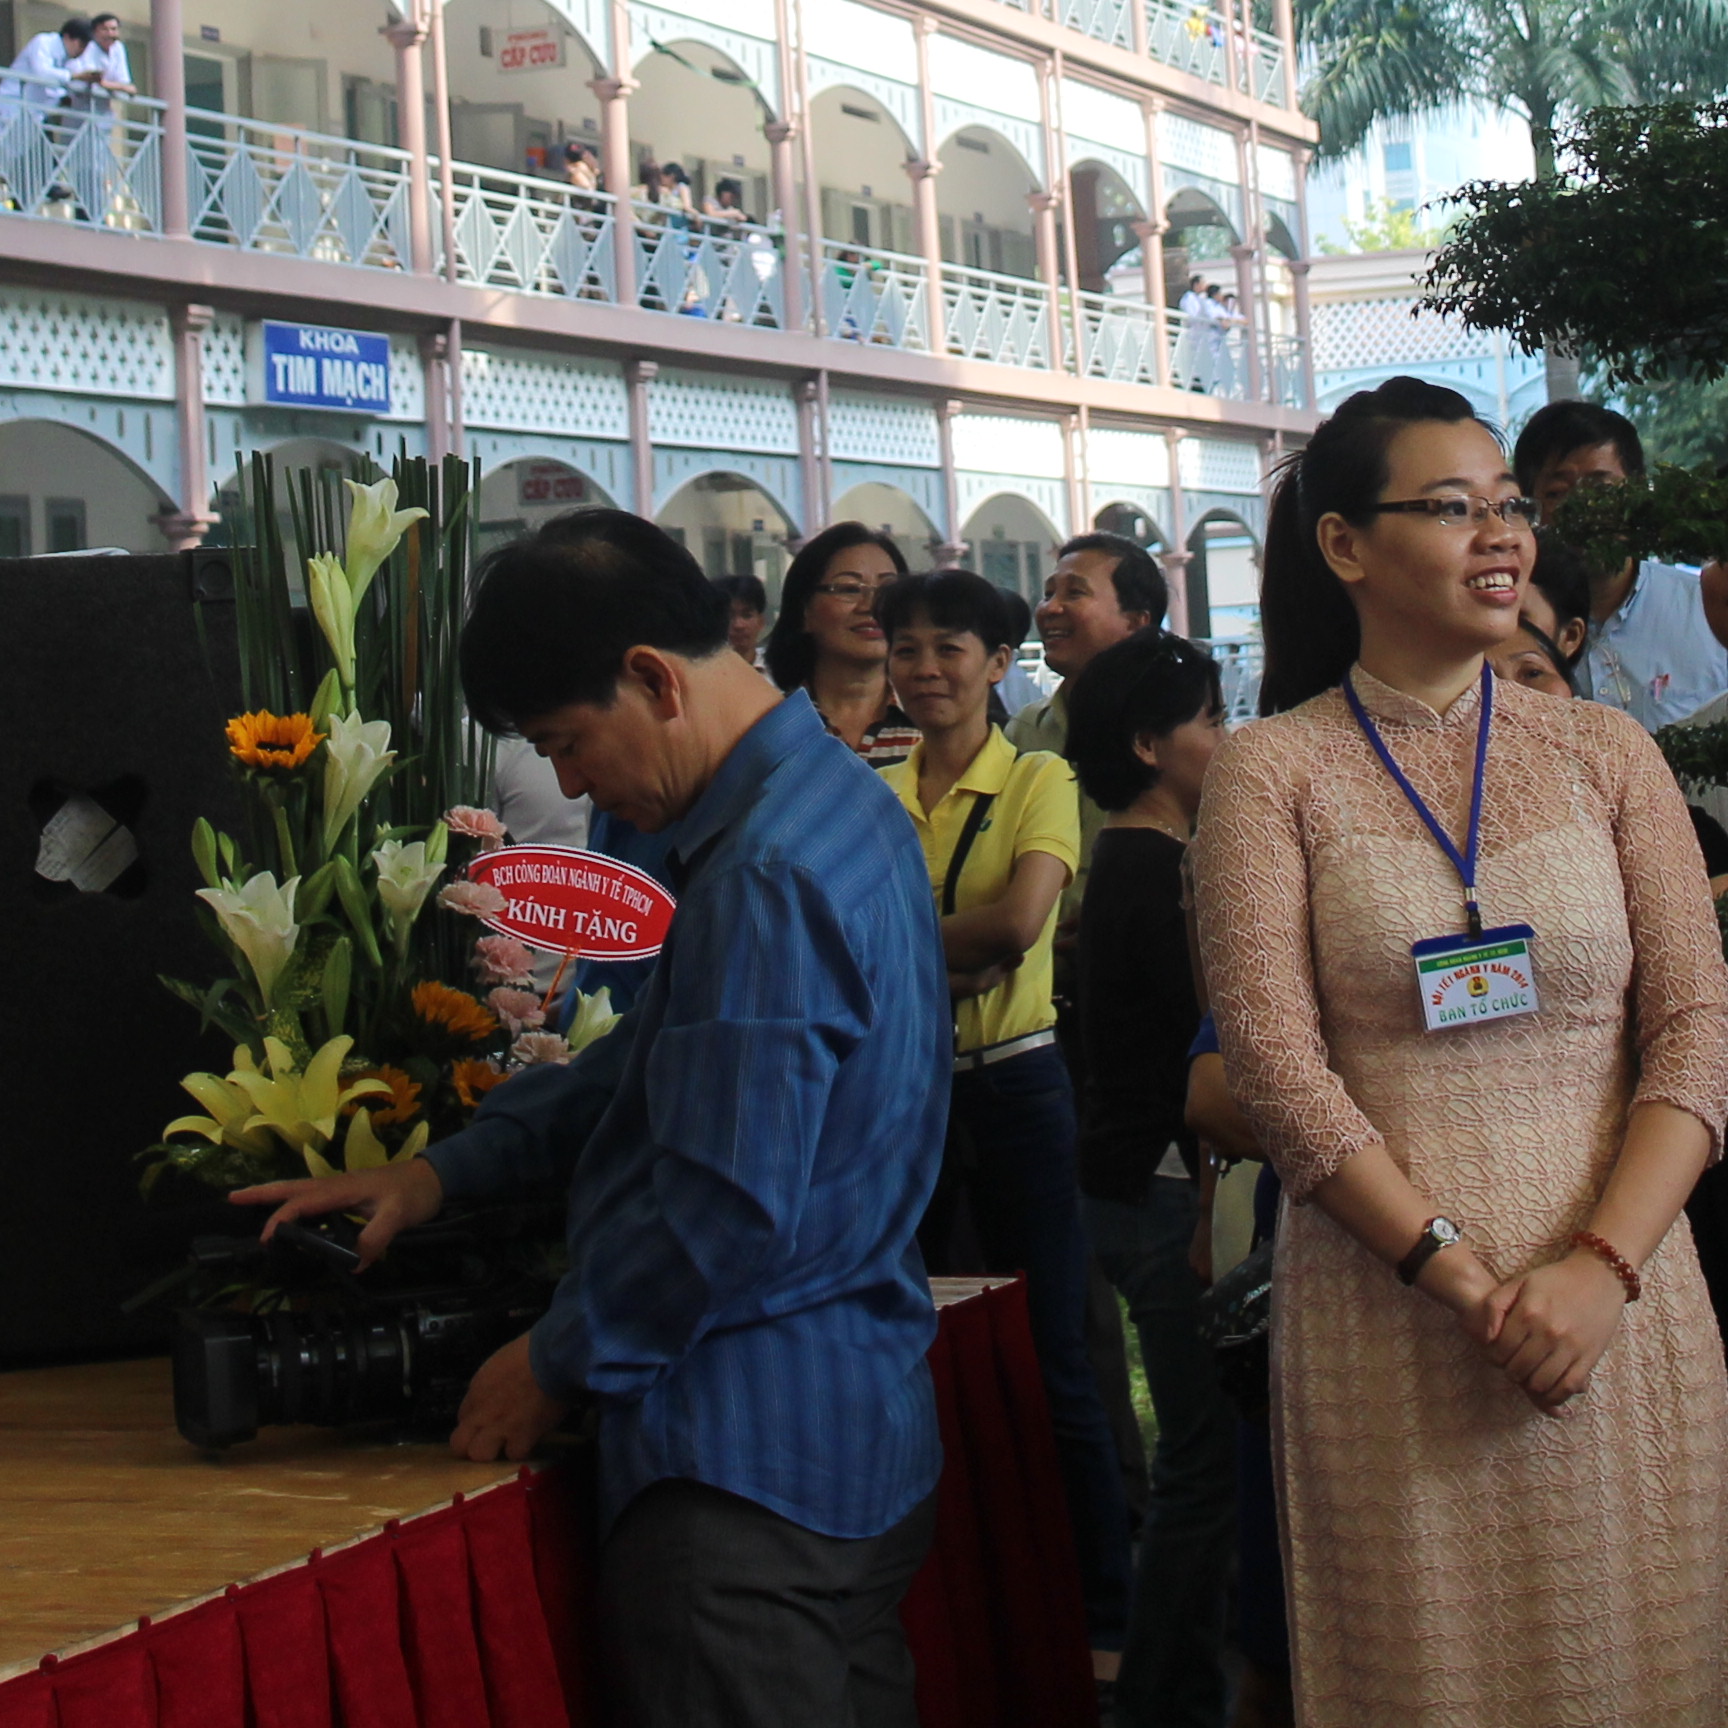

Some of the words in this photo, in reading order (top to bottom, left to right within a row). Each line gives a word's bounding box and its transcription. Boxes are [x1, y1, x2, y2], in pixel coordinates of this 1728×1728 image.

[299, 329, 360, 355] KHOA
[271, 352, 317, 395] TIM
[321, 357, 386, 406] MẠCH
[492, 865, 514, 887] BCH
[515, 859, 541, 883] CÔNG
[541, 860, 568, 885] ĐOÀN
[567, 865, 601, 893] NGÀNH
[601, 876, 610, 895] Y
[609, 874, 625, 900] TẾ
[622, 884, 654, 917] TPHCM
[507, 895, 567, 930] KÍNH
[573, 909, 638, 944] TẶNG
[1439, 1006, 1466, 1022] BAN
